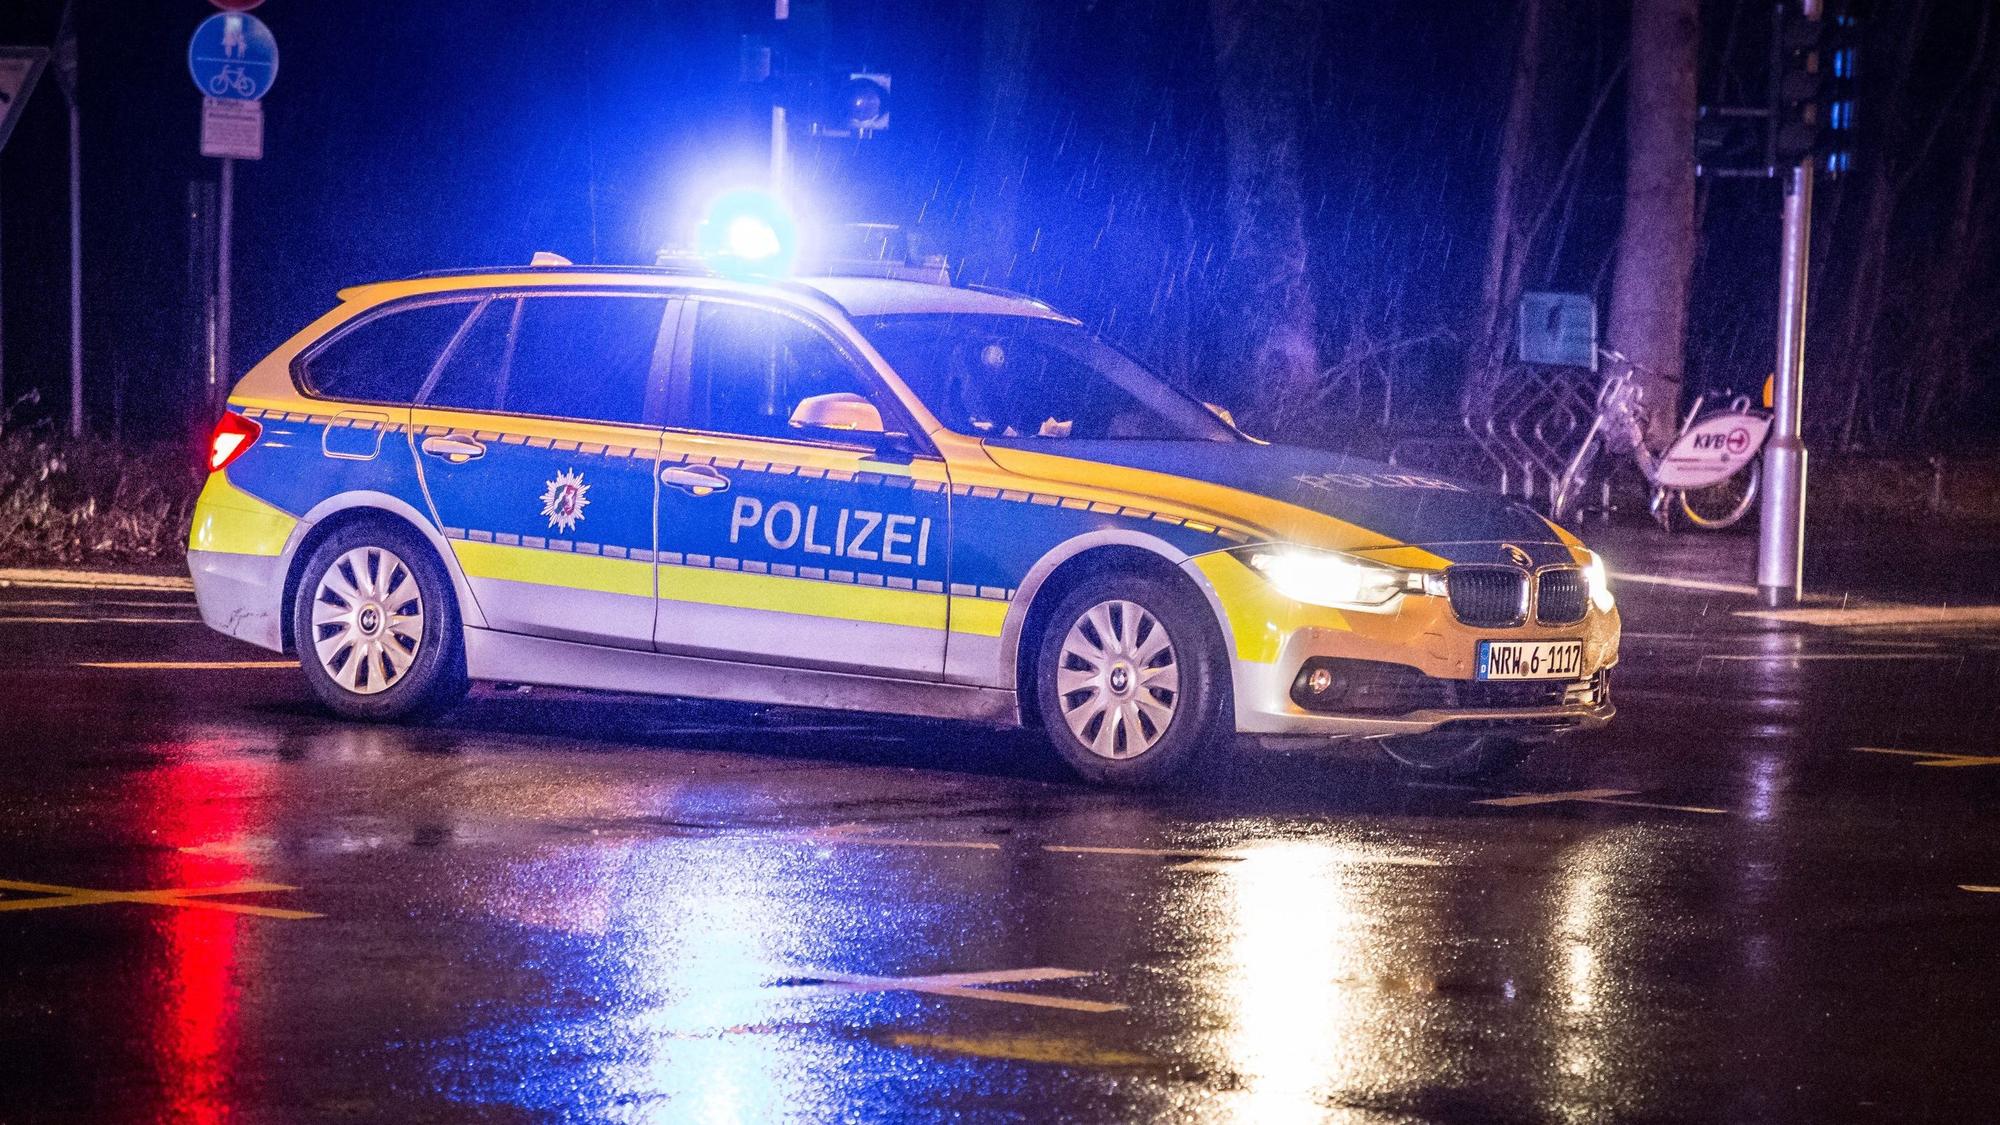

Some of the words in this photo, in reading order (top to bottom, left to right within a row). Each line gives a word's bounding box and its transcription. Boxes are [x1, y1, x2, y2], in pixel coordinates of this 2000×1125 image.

[1693, 433, 1726, 449] KVB
[729, 495, 931, 566] POLIZEI
[1489, 646, 1522, 675] NRW
[1530, 645, 1580, 674] 6-1117
